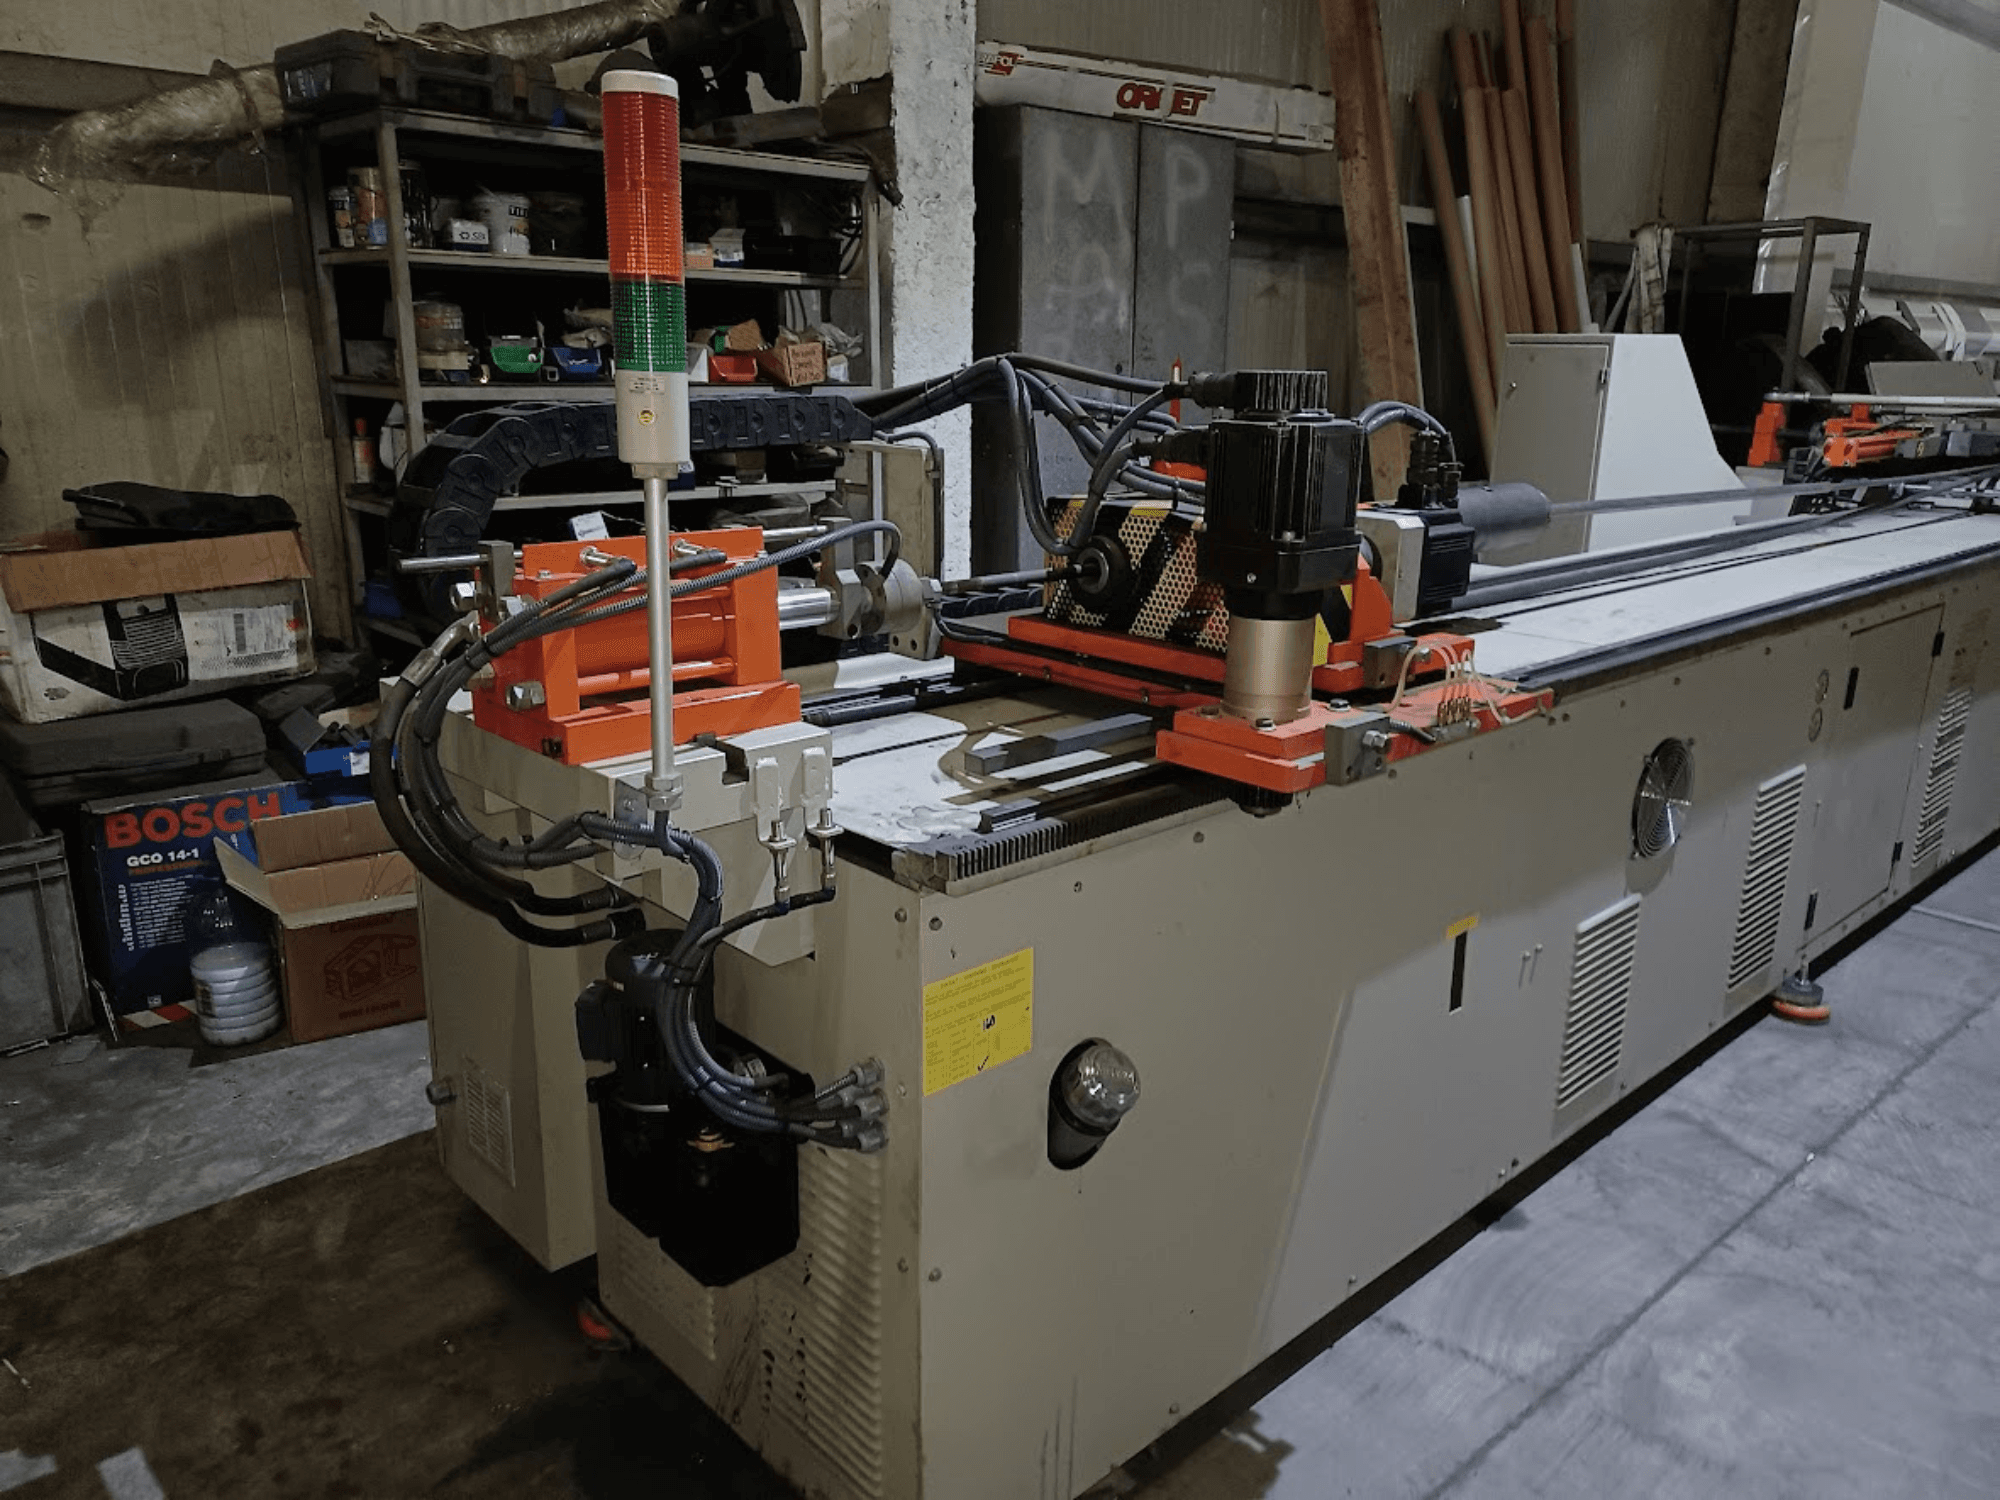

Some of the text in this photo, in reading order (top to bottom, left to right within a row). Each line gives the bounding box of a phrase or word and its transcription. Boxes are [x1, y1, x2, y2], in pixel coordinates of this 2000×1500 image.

[1165, 142, 1209, 249] P
[105, 792, 281, 848] BOSCH
[126, 852, 164, 868] GCO
[167, 847, 200, 863] 14-1
